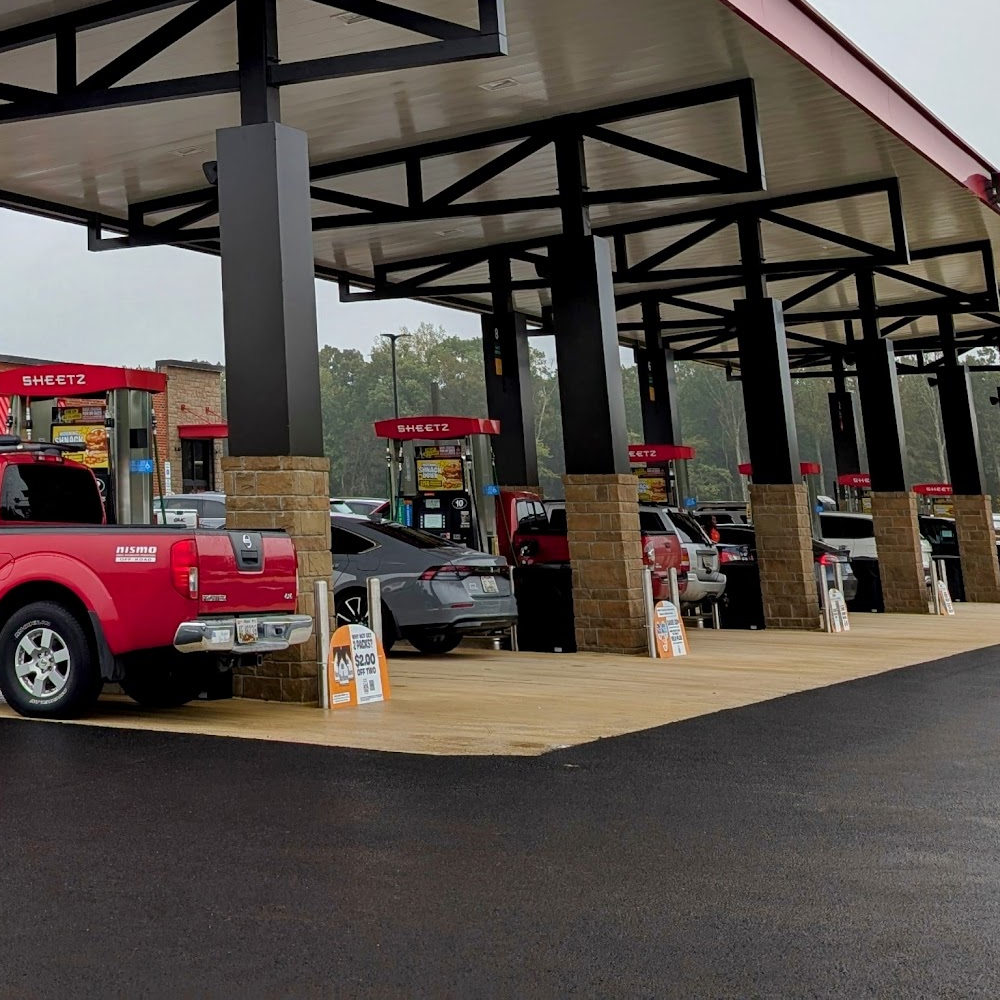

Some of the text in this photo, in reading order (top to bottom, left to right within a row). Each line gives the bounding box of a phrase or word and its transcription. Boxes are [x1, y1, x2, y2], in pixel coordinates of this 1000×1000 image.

[22, 374, 86, 386] SHEETZ
[397, 423, 450, 433] SHEETZ
[628, 449, 657, 458] EETZ
[455, 499, 464, 507] 10
[355, 652, 376, 668] $2.00
[357, 666, 377, 676] OFF TWO
